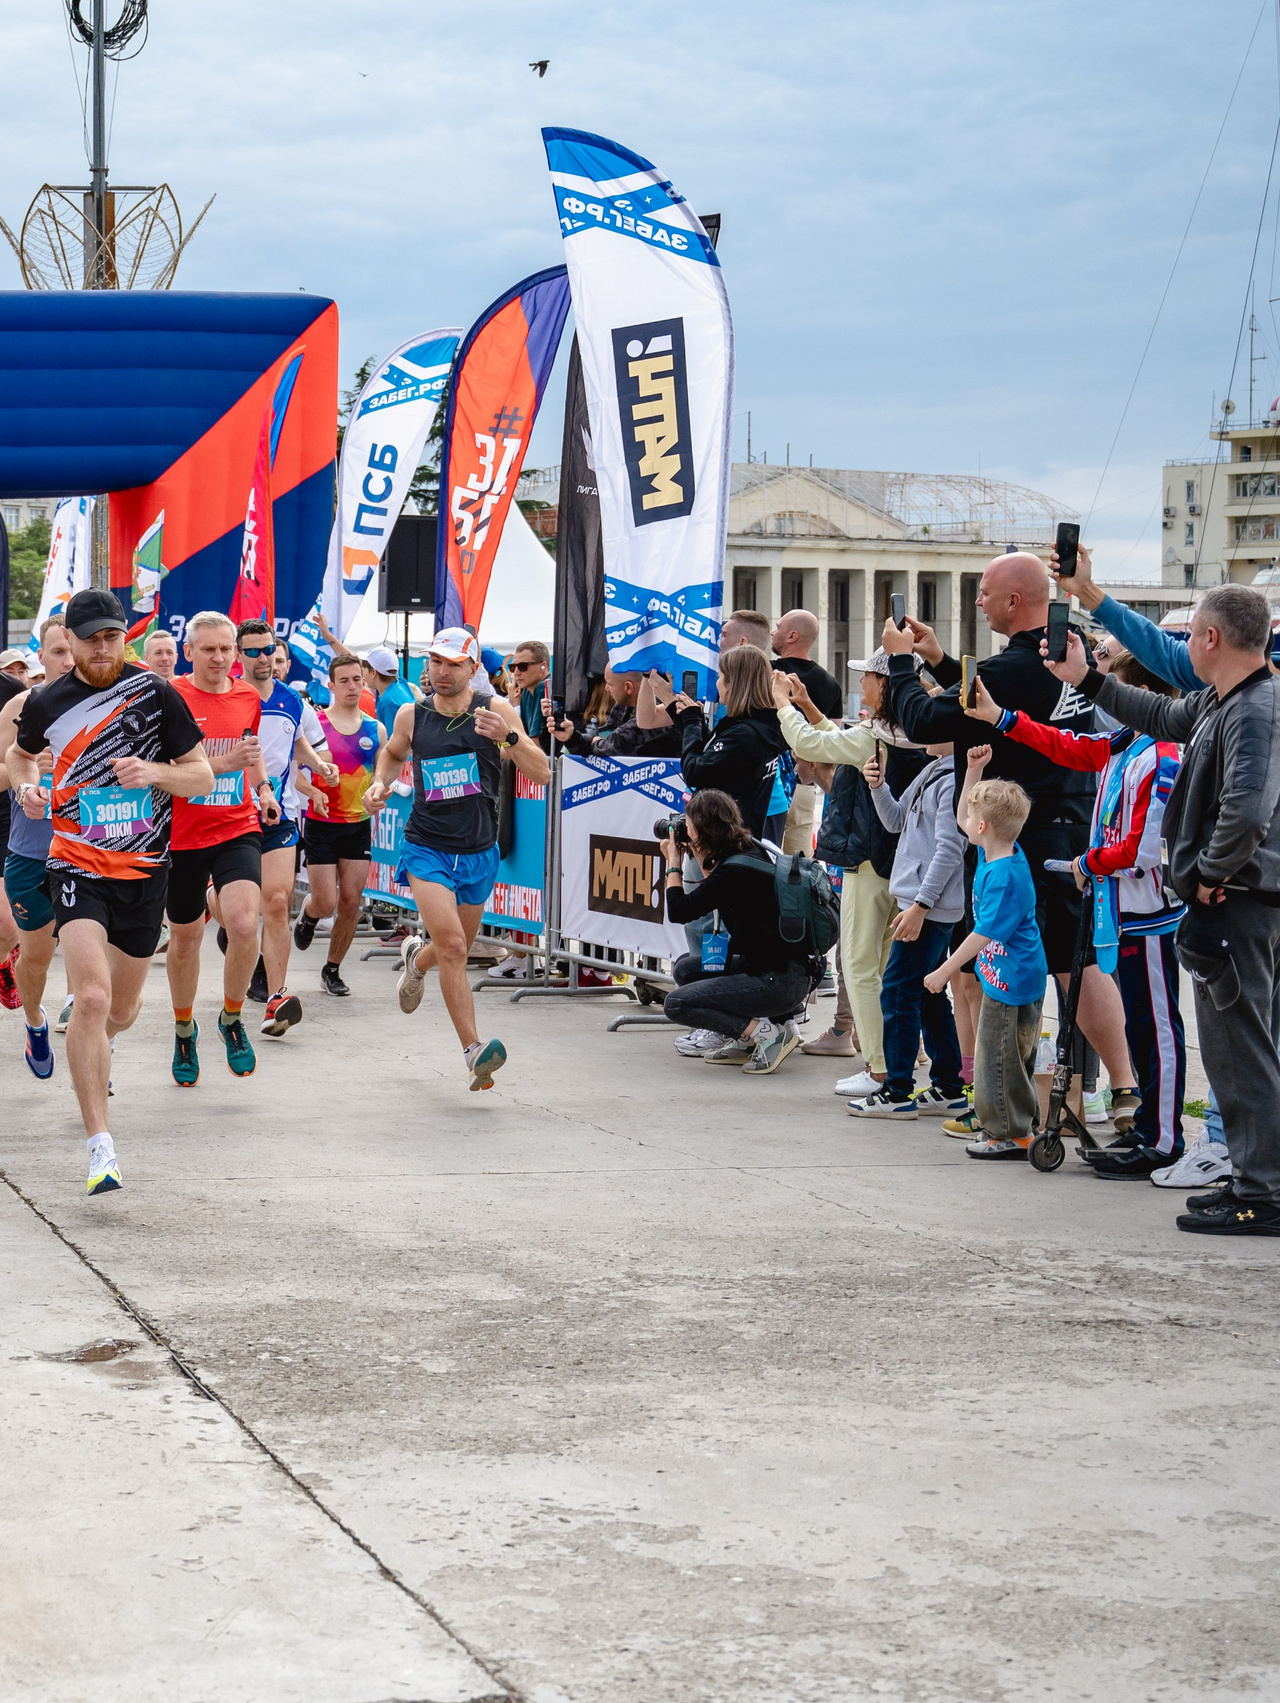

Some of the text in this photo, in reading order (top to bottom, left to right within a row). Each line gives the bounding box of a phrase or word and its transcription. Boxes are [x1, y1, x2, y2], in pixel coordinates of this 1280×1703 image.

[352, 443, 399, 537] ПСБ
[576, 485, 599, 496] ЛИГА
[433, 768, 468, 788] 30136
[622, 761, 666, 787] ЗАБЕГ.РФ
[441, 785, 465, 800] 10KM
[571, 779, 611, 803] ЗАБЕГ.РФ
[96, 800, 138, 823] 30191
[103, 821, 133, 839] 10KM
[592, 848, 661, 909] МАТЧ!
[509, 884, 543, 923] #МЕЧТА
